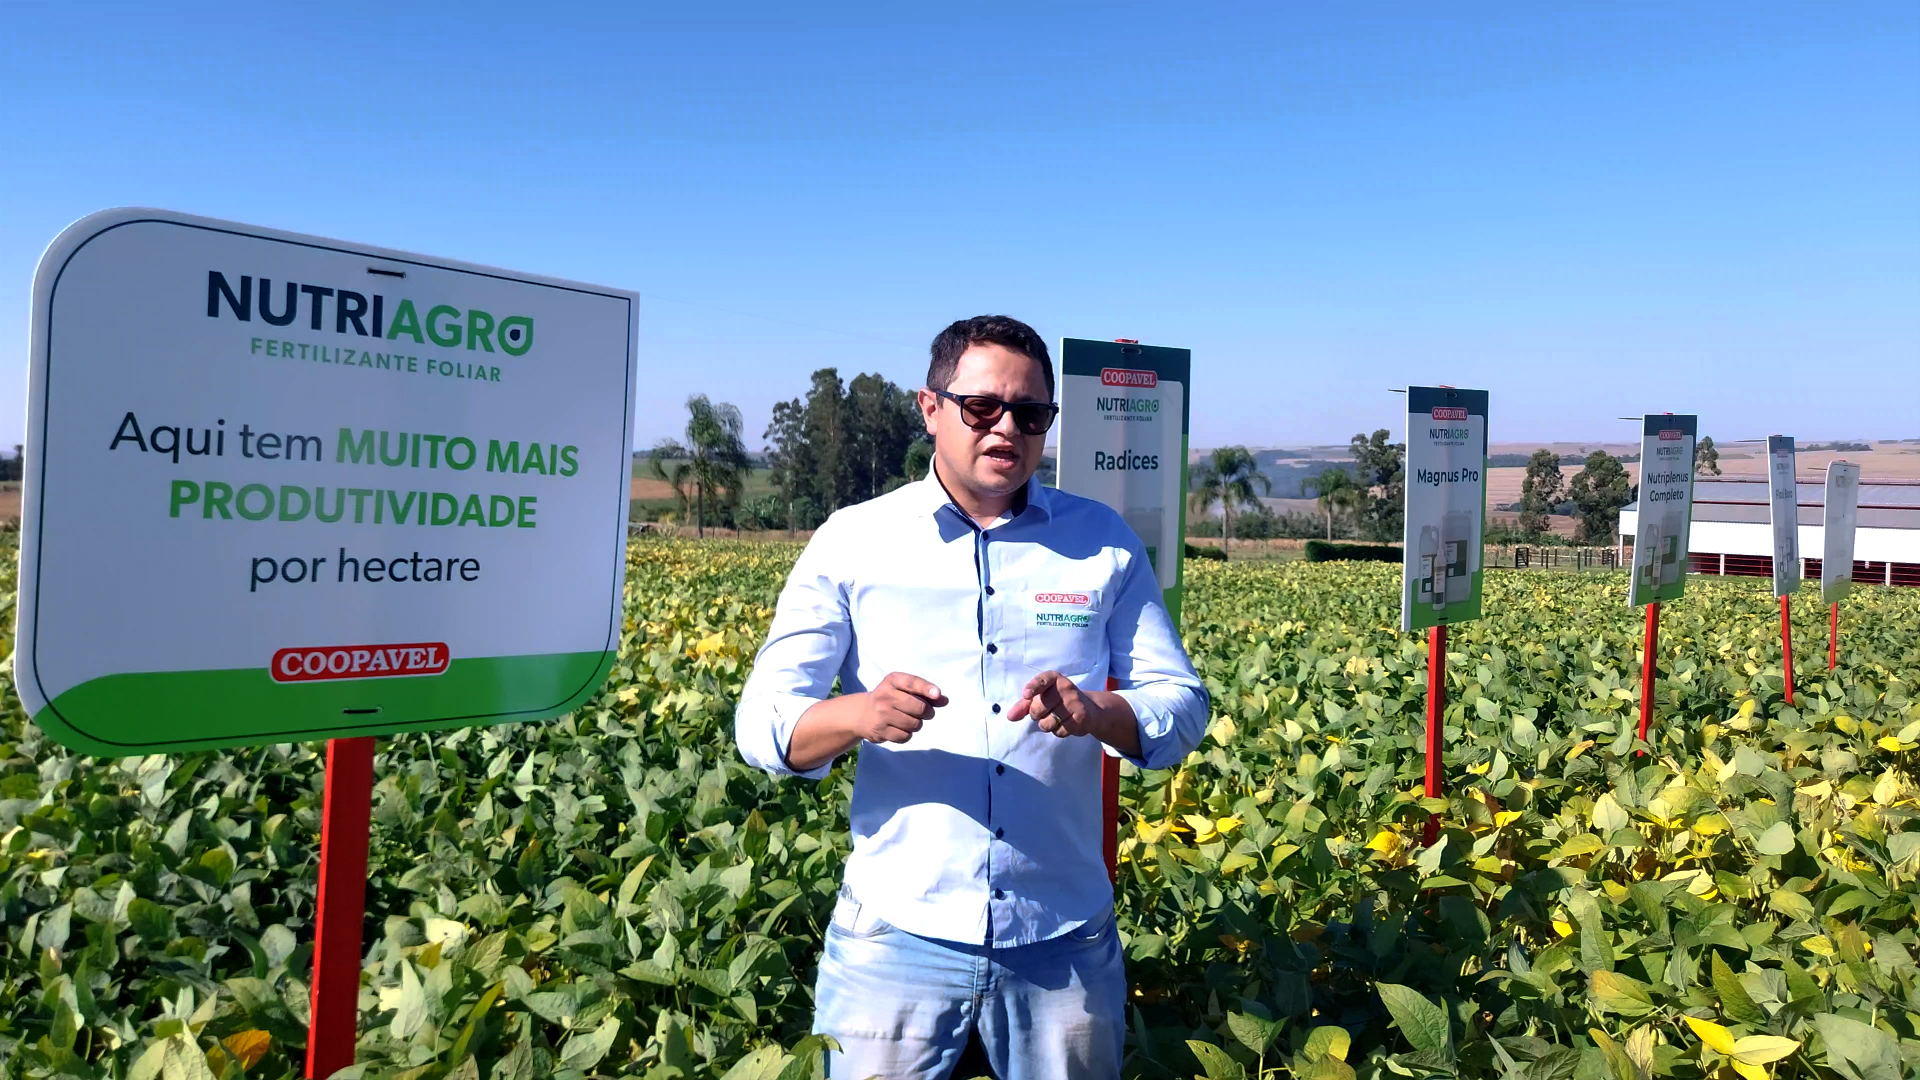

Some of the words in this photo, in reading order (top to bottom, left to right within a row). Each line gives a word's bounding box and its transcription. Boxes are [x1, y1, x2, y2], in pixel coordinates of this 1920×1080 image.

[206, 270, 534, 357] NUTRIAGRO
[250, 337, 418, 374] FERTILIZANTE
[426, 359, 502, 383] FOLIAR
[1103, 371, 1155, 385] COOPAVEL
[1096, 397, 1159, 413] NUTRIAGRO
[1434, 409, 1466, 418] COOPAVEL
[109, 412, 225, 464] Aqui
[239, 424, 322, 462] tem
[335, 427, 476, 470] MUITO
[486, 440, 579, 477] MAIS
[1094, 449, 1159, 471] Radices
[1417, 468, 1459, 486] Magnus
[1462, 468, 1478, 482] Pro
[1648, 471, 1688, 486] Nutriplenus
[169, 480, 538, 529] PRODUTIVIDADE
[1650, 488, 1683, 503] Completo
[249, 553, 326, 593] por
[337, 547, 481, 583] hectare
[1037, 594, 1087, 603] COOPAVEL
[1036, 613, 1089, 622] NUTRIAGRO
[279, 648, 445, 675] COOPAVEL
